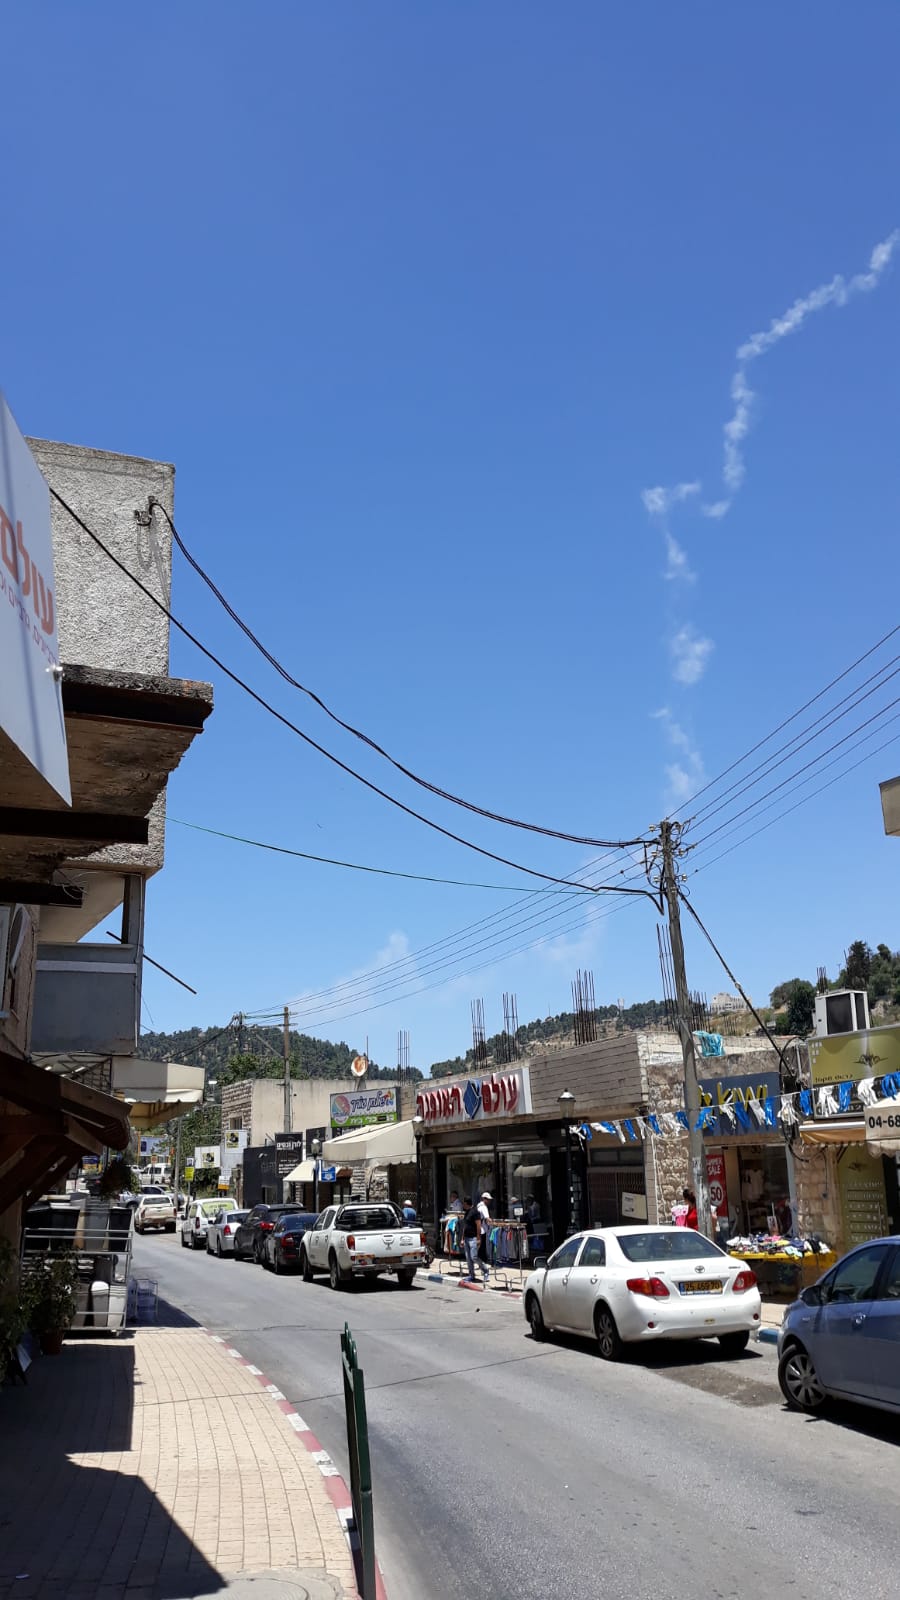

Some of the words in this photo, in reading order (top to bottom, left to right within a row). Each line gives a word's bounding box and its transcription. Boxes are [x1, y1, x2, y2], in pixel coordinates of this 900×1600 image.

[416, 1084, 463, 1121] האופנה
[481, 1073, 519, 1113] עולם
[710, 1186, 722, 1202] 50
